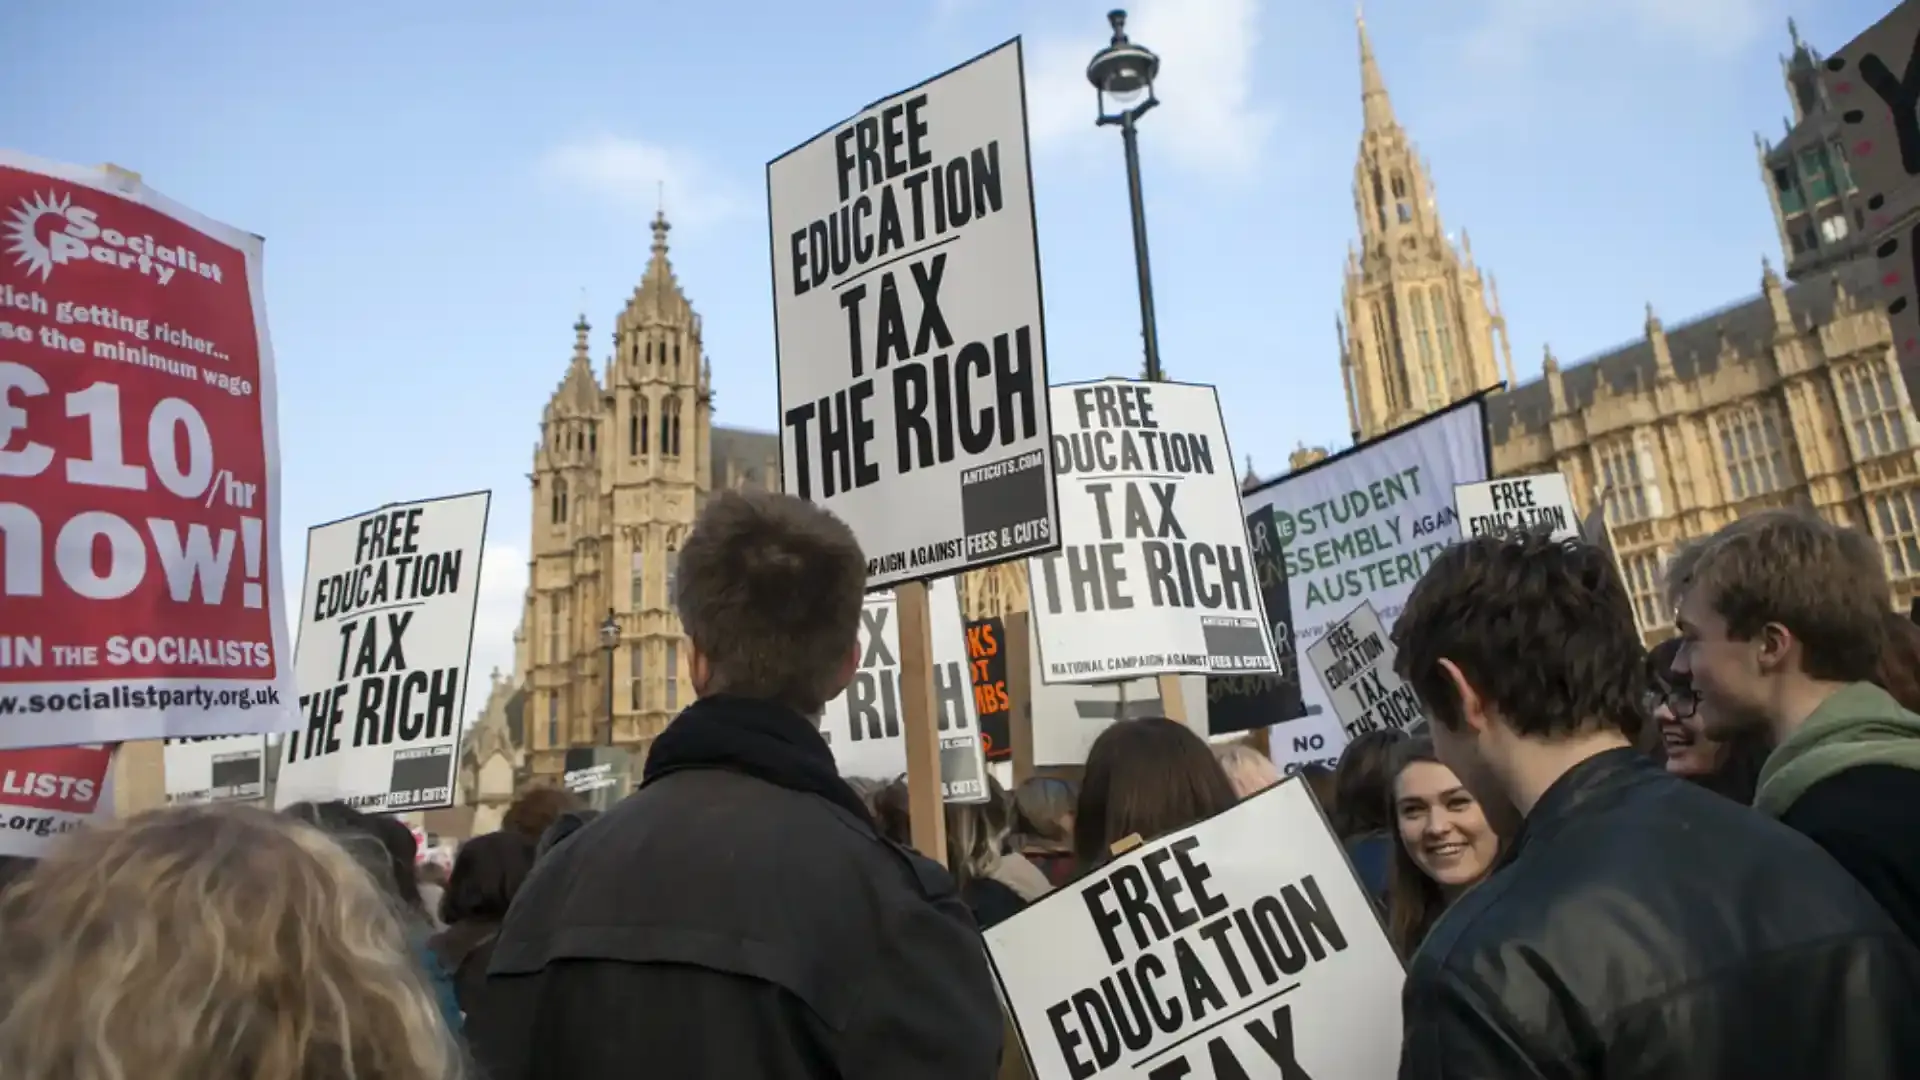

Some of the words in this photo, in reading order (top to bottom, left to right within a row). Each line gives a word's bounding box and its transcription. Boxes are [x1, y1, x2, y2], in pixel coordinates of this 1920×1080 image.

[834, 93, 932, 203] FREE
[64, 205, 222, 284] Socialist
[790, 139, 1004, 297] EDUCATION
[51, 231, 175, 285] Party
[55, 300, 150, 341] getting
[839, 251, 955, 379] TAX
[38, 325, 86, 354] the
[93, 340, 198, 381] minimum
[202, 366, 253, 396] wage
[785, 377, 880, 502] THE
[892, 324, 1037, 475] RICH
[1073, 385, 1159, 429] FREE
[962, 450, 1043, 486] ANTICUTS.COM
[1053, 430, 1215, 475] DUCATION
[1084, 481, 1187, 541] TAX
[1297, 465, 1421, 536] STUDENT
[1488, 479, 1537, 511] FREE
[354, 507, 424, 565] FREE
[909, 537, 963, 569] AGAINST
[967, 530, 998, 556] FEES
[1001, 527, 1012, 549] &
[1013, 517, 1050, 545] CUTS
[313, 548, 463, 622] EDUCATION
[1034, 542, 1134, 614] THE
[1141, 540, 1252, 611] RICH
[51, 646, 98, 667] THE
[106, 635, 271, 668] SOCIALISTS
[338, 610, 415, 682] TAX
[1051, 658, 1103, 675] NATIONAL
[288, 682, 349, 765] THE
[352, 667, 458, 747] RICH
[847, 661, 968, 742] RIH
[1349, 667, 1389, 711] TAX
[1376, 681, 1424, 730] RICH
[1293, 734, 1325, 752] NO
[1081, 835, 1229, 965] FREE
[1046, 874, 1349, 1080] EDUCATION
